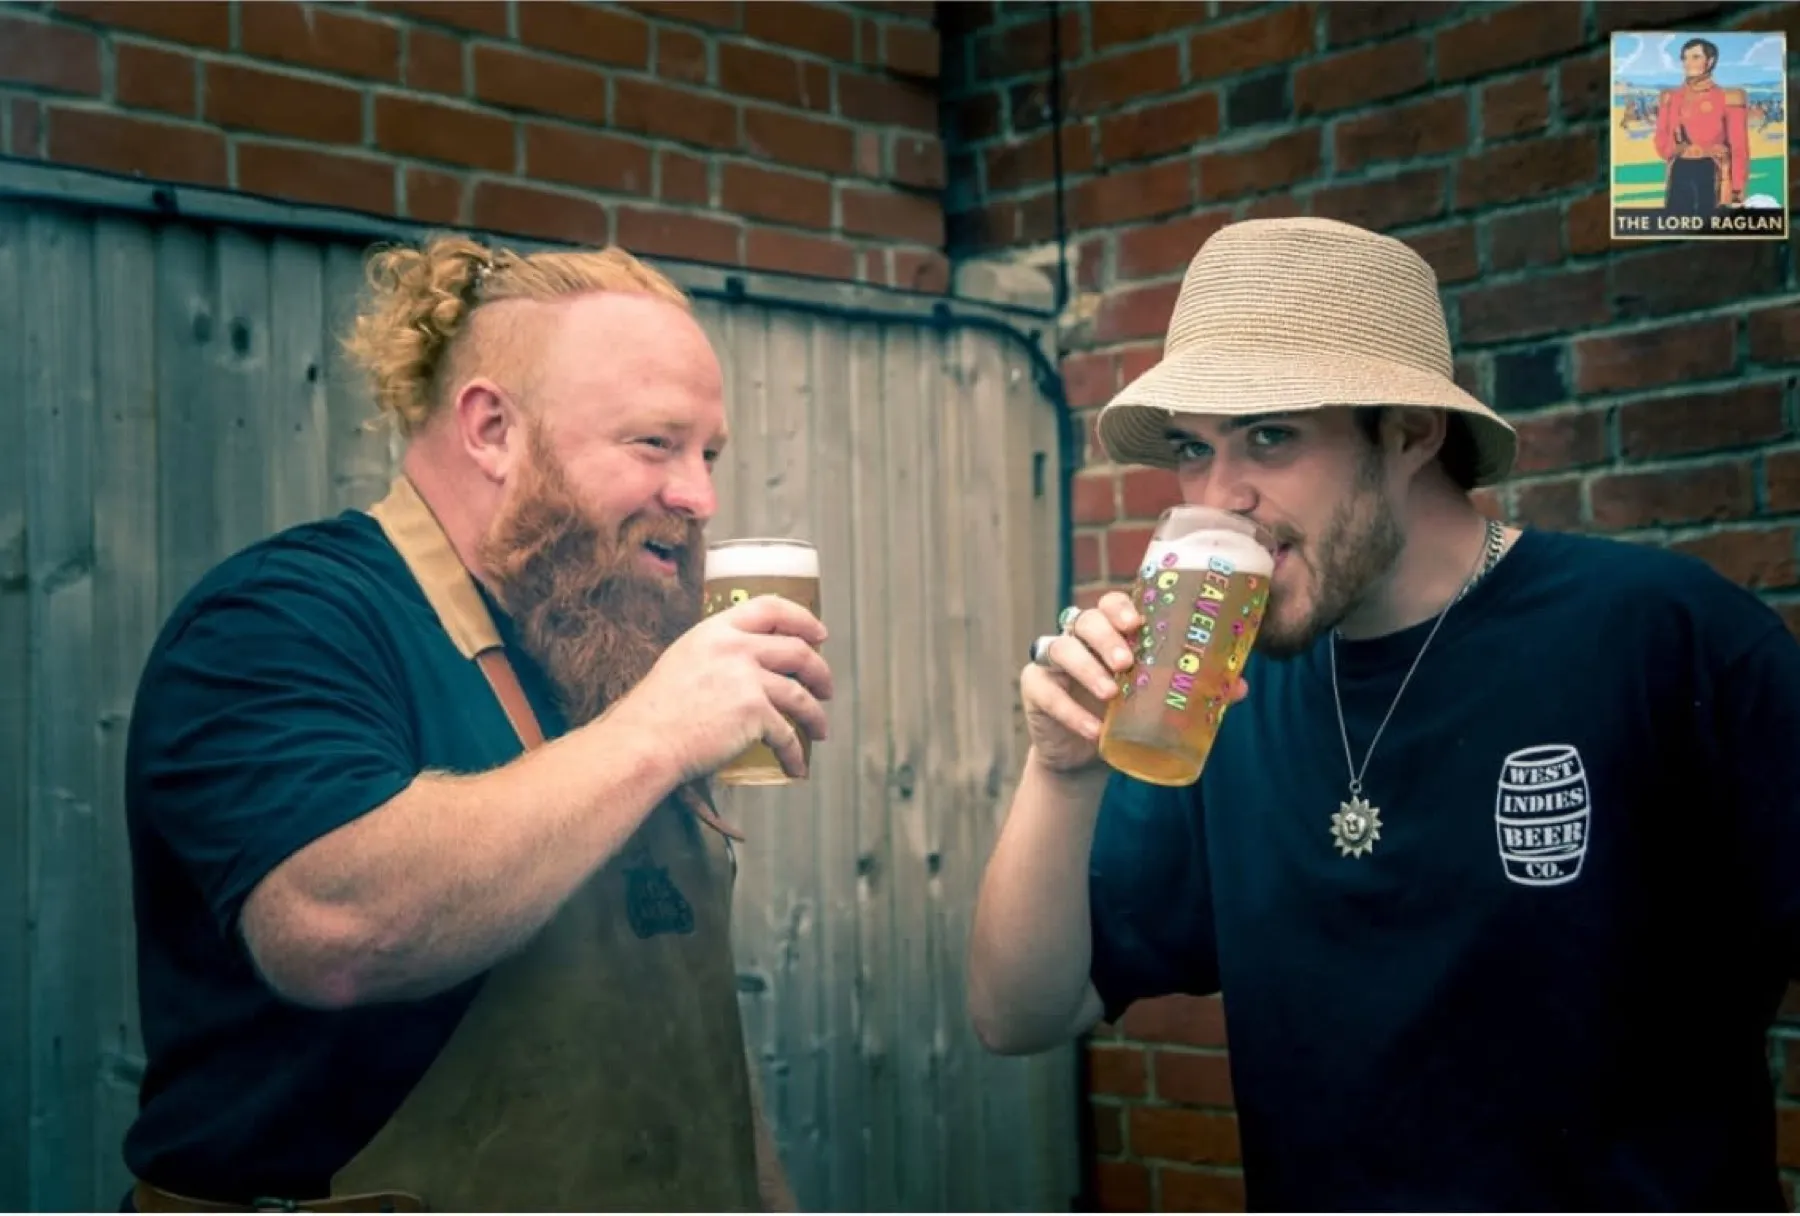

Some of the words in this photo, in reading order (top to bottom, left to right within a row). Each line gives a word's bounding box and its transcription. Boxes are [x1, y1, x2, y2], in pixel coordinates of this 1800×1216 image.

[1165, 556, 1234, 710] BEAVERTOWN
[1510, 761, 1574, 784] WEST
[1503, 787, 1584, 812] INDIES
[1503, 822, 1582, 847] BEER
[1526, 862, 1564, 878] CO.
